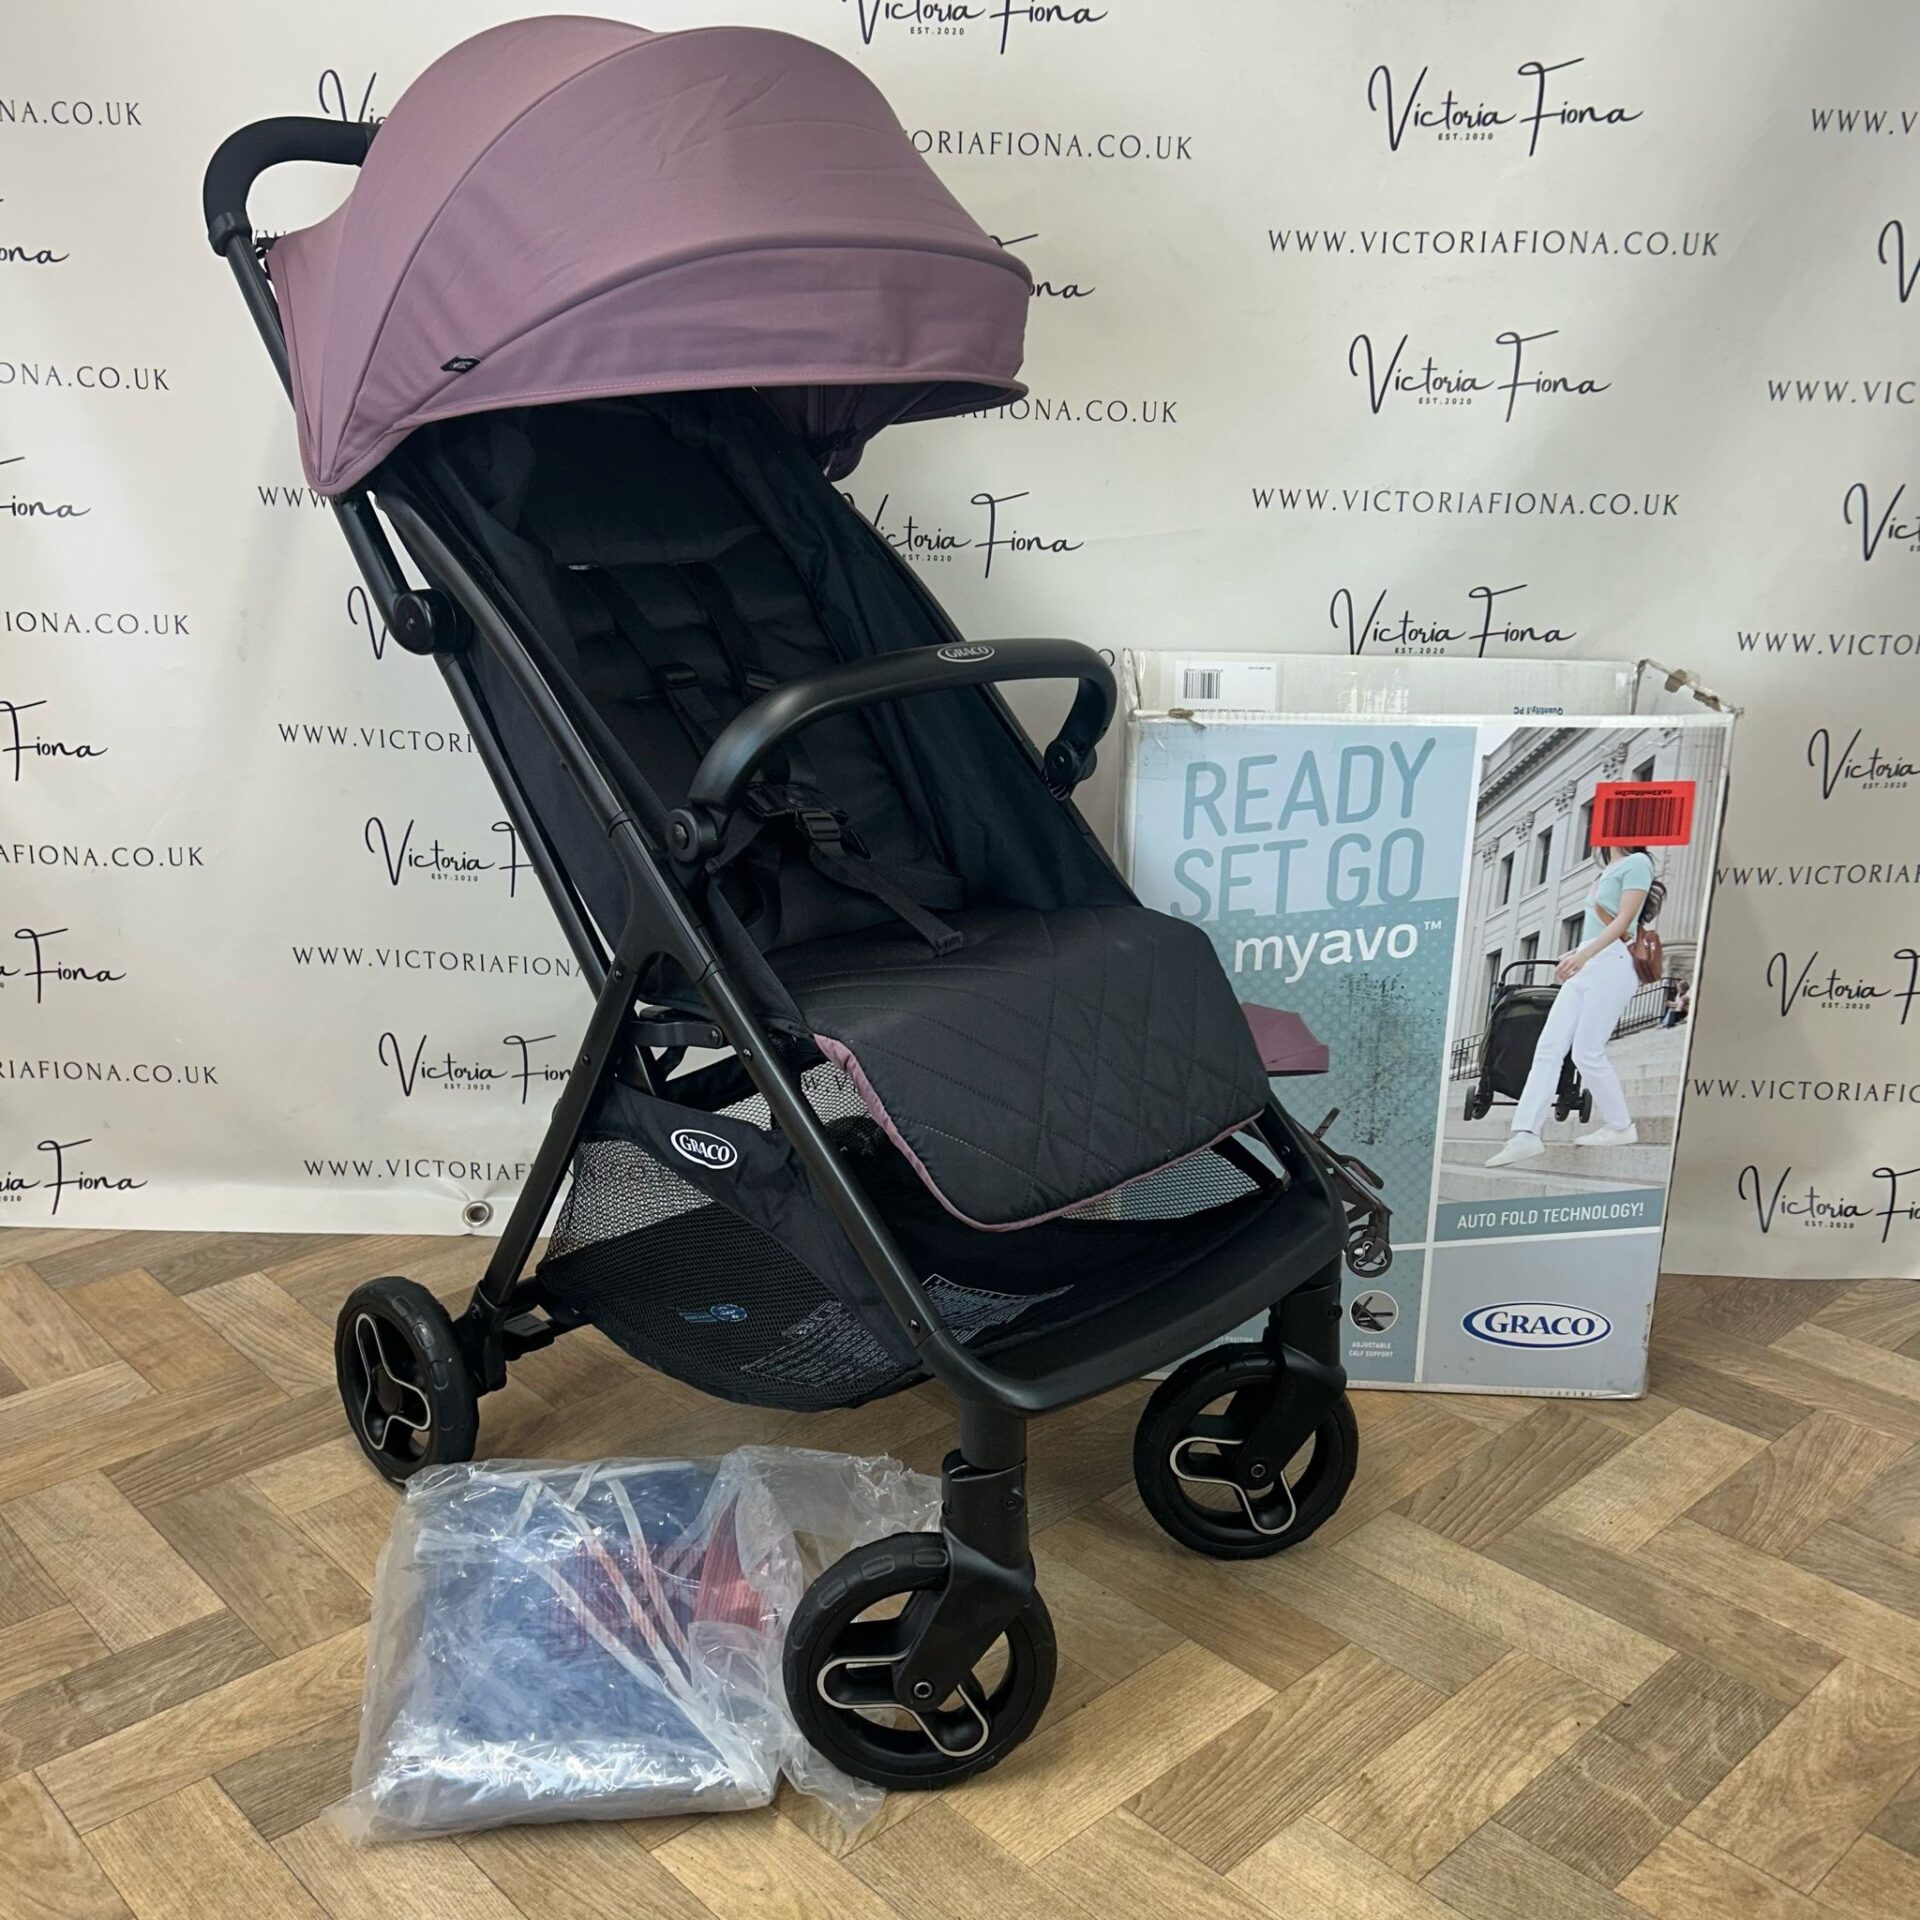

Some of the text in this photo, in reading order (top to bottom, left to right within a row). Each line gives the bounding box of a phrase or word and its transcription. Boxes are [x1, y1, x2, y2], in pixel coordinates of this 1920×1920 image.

[910, 27, 965, 35] EST.2020
[1368, 57, 1643, 156] Victoria Fiona
[1812, 108, 1919, 134] WWW.V
[904, 129, 1193, 160] ORIAFIONA.CO.UK
[1438, 133, 1494, 141] EST.2020
[1268, 229, 1720, 257] WWW.VICTORIAFIONA.CO.UK
[1349, 330, 1612, 422] Victoria Fiona
[1418, 397, 1472, 405] EST.2020
[1768, 380, 1917, 404] WWW.VIC
[1252, 488, 1680, 516] WWW.VICTORIAFIONA.CO.UK
[970, 491, 1084, 579] Fiona
[1330, 584, 1577, 658] Victoria Fiona
[279, 723, 480, 753] WWW.VICTORI
[1808, 728, 1920, 800] Victoria
[1183, 737, 1437, 840] READY
[365, 817, 495, 885] Victoria
[431, 873, 479, 882] EST.2020
[1170, 828, 1425, 922] SET GO
[14, 928, 127, 1004] Fiona
[1234, 923, 1418, 984] myavo
[1766, 951, 1891, 1017] Victoria
[378, 1032, 508, 1096] Victoria
[679, 1134, 730, 1162] GRACO
[37, 1138, 149, 1215] Fiona
[304, 1159, 535, 1181] WWW.VICTORIAF
[1738, 1165, 1874, 1233] Victoria
[1457, 1202, 1644, 1229] AUTO FOLD TECHNOLOGY!
[1484, 1311, 1596, 1337] GRACO
[1351, 1341, 1392, 1349] ADJUSTABLE
[1365, 1350, 1393, 1358] SUPPORT
